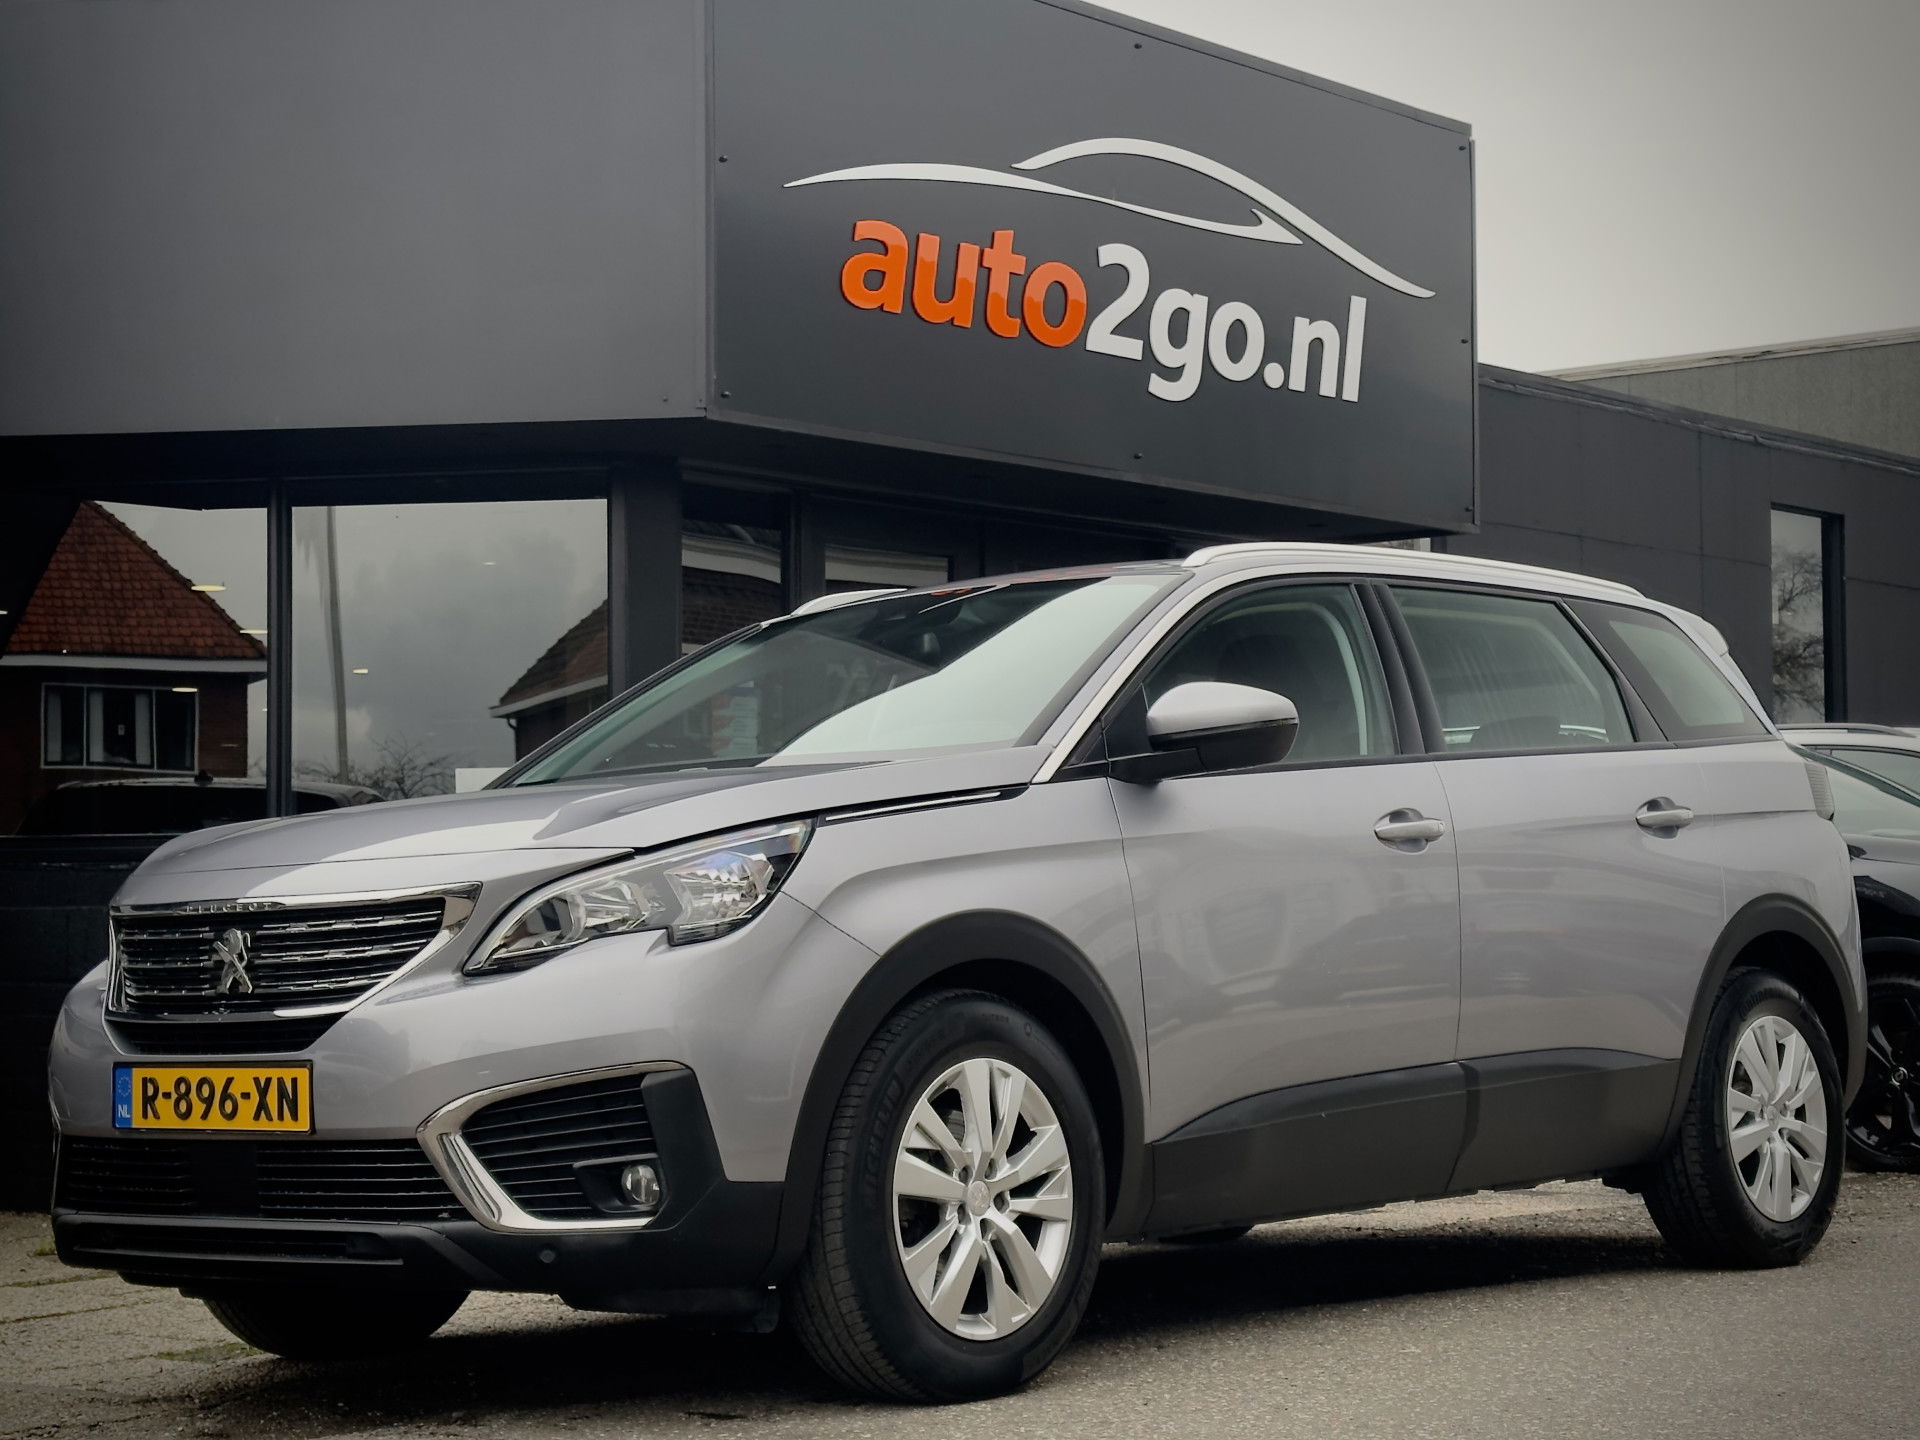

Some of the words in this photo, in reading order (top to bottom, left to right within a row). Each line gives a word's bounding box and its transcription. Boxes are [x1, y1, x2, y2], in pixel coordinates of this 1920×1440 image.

[841, 219, 1367, 402] auto2go.nl
[118, 1105, 131, 1119] NL
[141, 1076, 298, 1121] R-896-XN
